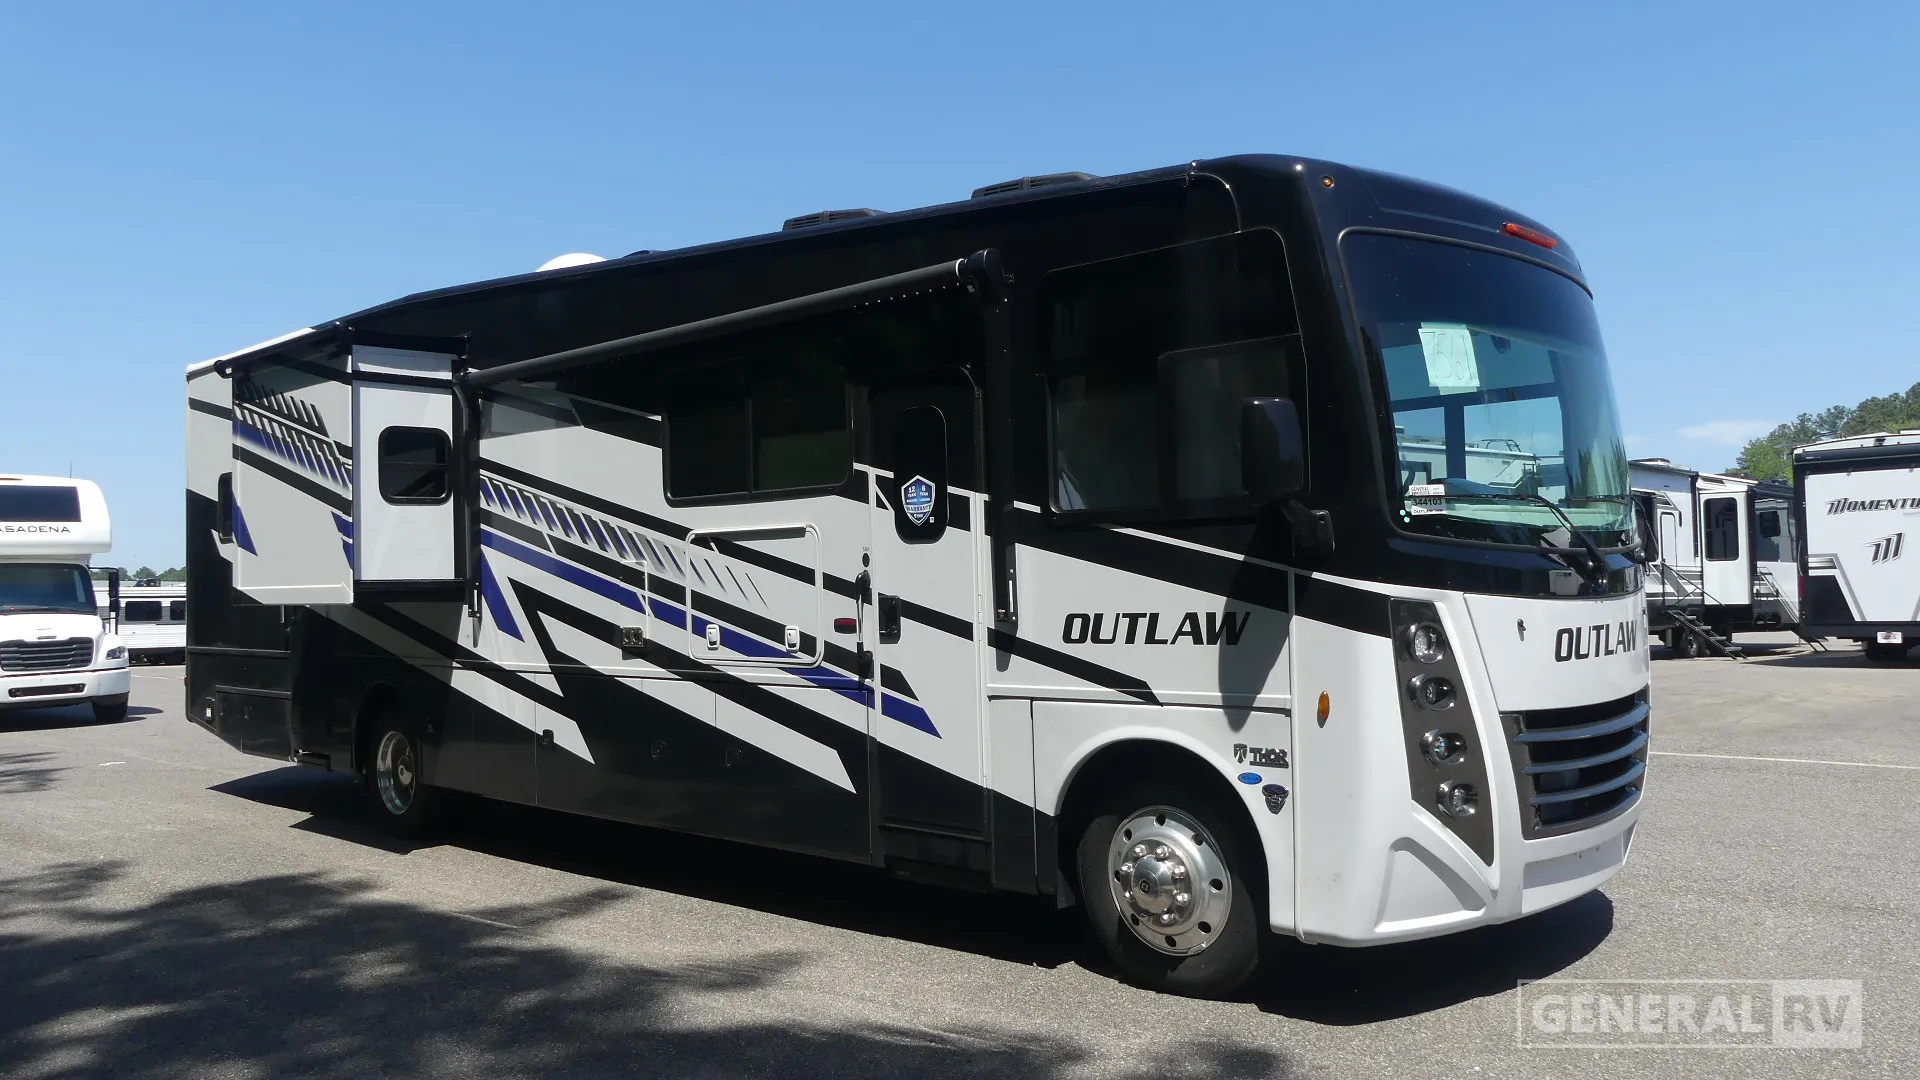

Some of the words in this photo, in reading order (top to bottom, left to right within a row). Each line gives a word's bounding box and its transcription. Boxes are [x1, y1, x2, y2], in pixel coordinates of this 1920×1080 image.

[1412, 498, 1442, 506] 344103
[1061, 611, 1251, 645] OUTLAW
[1554, 619, 1637, 662] OUTLAW
[1249, 747, 1289, 763] THOR
